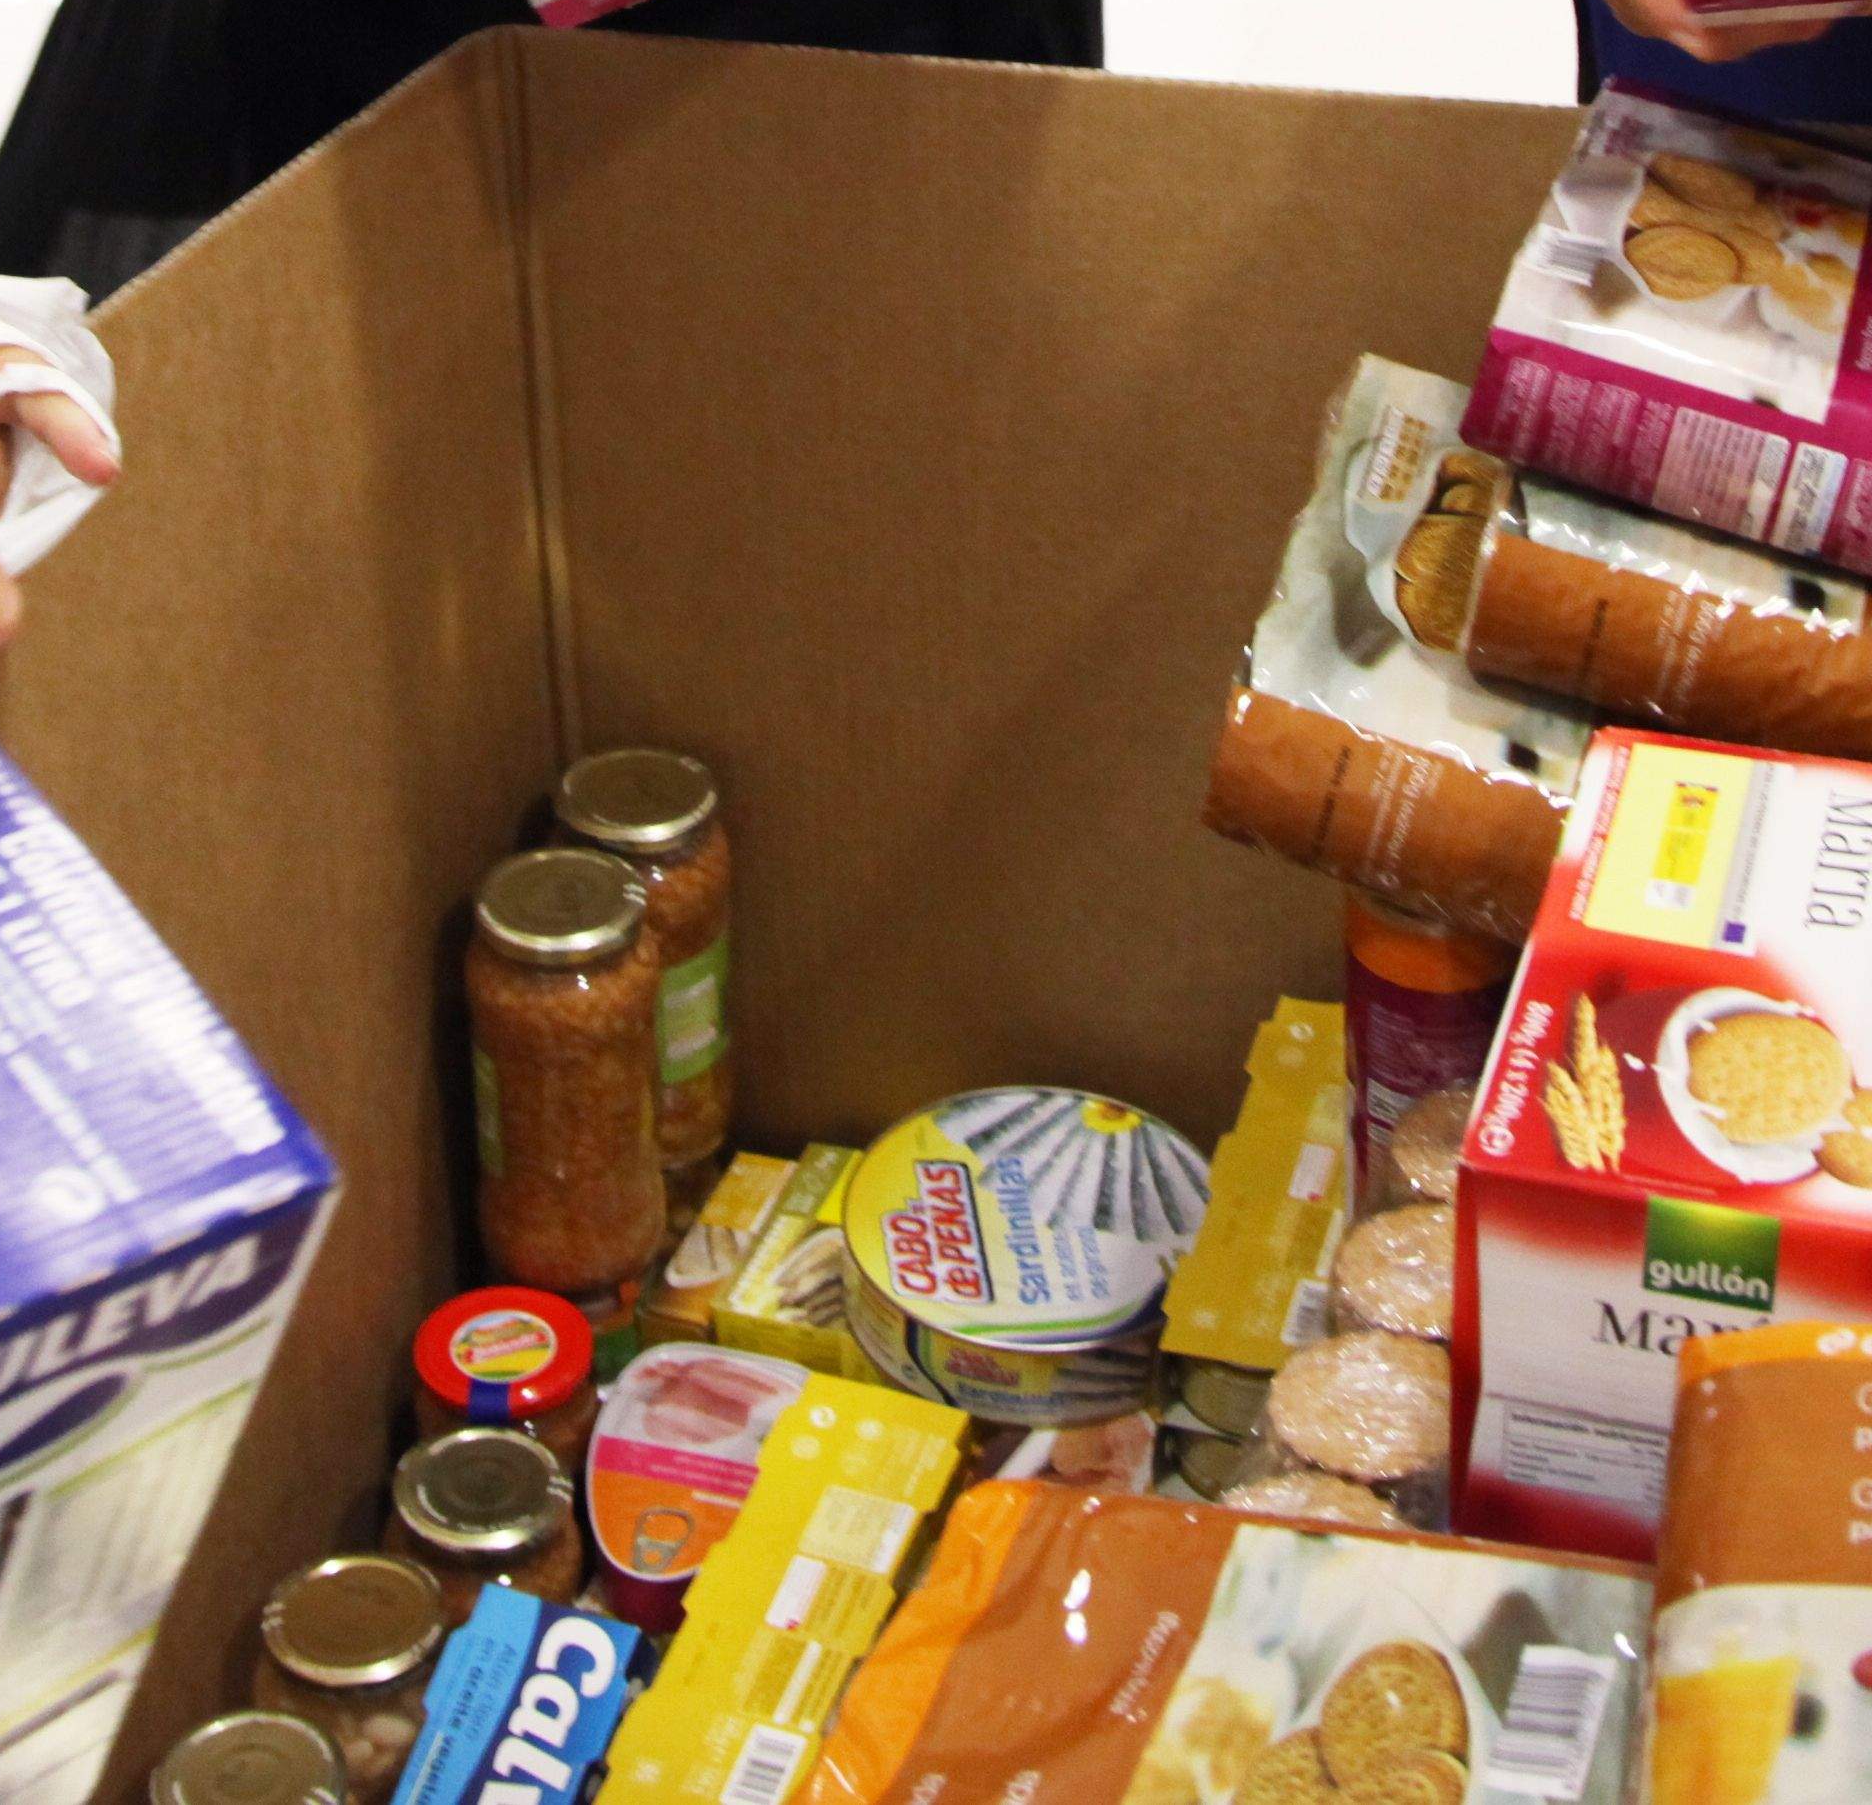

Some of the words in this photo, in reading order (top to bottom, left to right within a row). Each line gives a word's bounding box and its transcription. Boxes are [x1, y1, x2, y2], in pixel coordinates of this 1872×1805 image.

[889, 1213, 938, 1296] CABO
[996, 1156, 1052, 1306] Sardinillas
[1647, 1257, 1771, 1303] gullón
